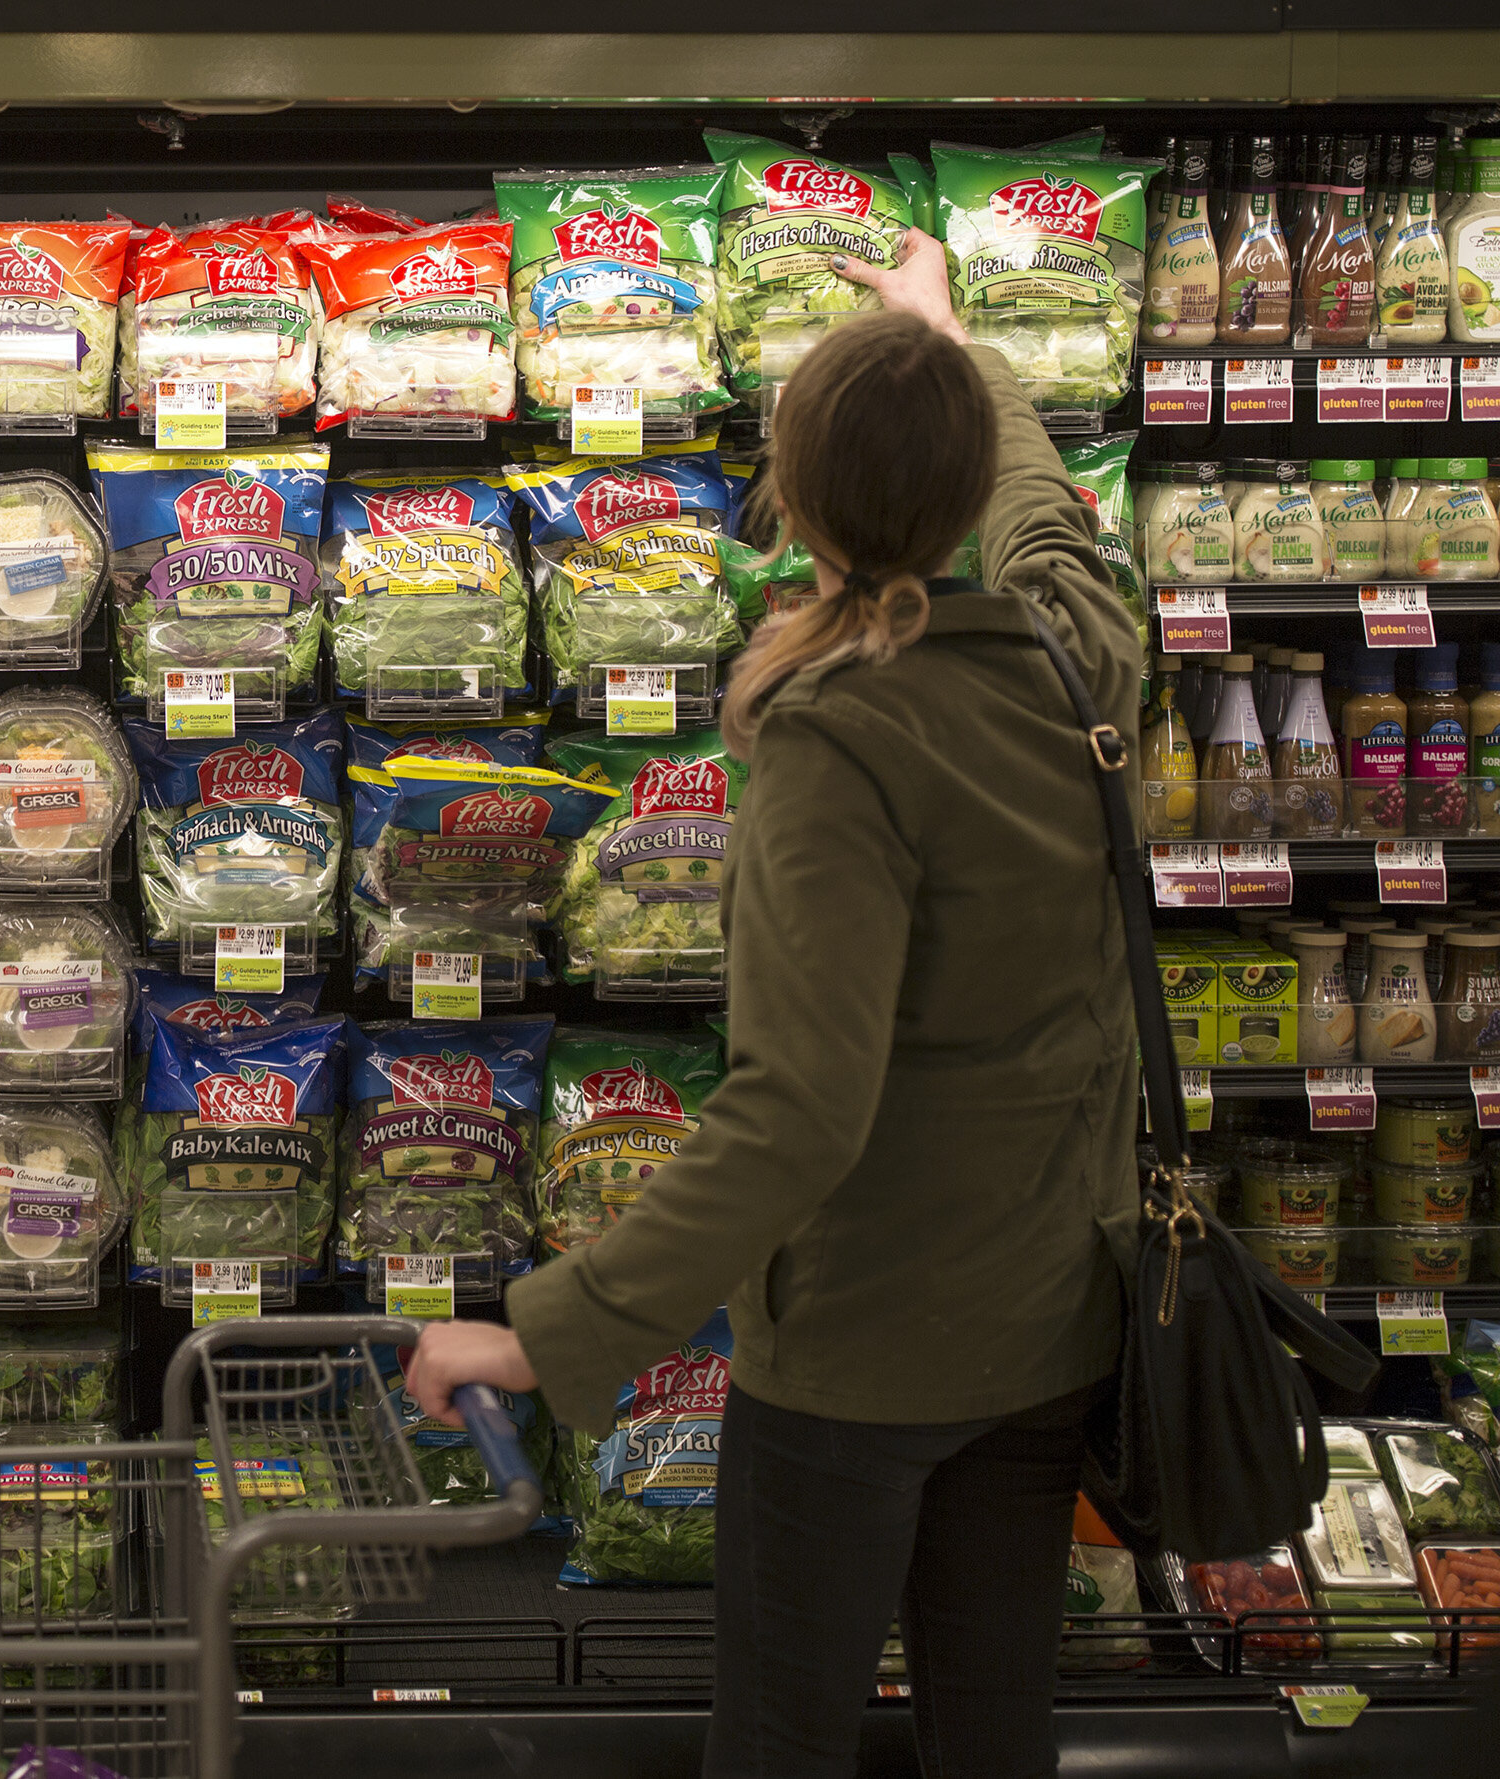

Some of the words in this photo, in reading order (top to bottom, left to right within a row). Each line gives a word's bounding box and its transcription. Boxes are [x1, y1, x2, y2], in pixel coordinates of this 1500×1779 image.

[780, 160, 860, 194] Fresh
[570, 218, 646, 243] Fresh
[570, 242, 648, 261] EXPRESS
[741, 229, 799, 261] Hearts
[798, 225, 820, 246] of
[819, 227, 884, 262] Romaine
[967, 250, 1030, 287] Hearts
[1030, 248, 1047, 270] of
[1047, 248, 1109, 285] Romaine
[1150, 251, 1215, 276] Marie's
[553, 271, 675, 300] American
[1182, 284, 1208, 294] WHITE
[189, 303, 248, 328] Iceberg
[248, 302, 304, 323] Garden
[1180, 307, 1215, 317] SHALLOT
[1149, 399, 1184, 412] gluten
[1185, 398, 1206, 411] free
[1389, 397, 1424, 411] gluten
[1424, 397, 1445, 410] free
[181, 423, 204, 431] Guiding
[192, 487, 270, 517] Fresh
[192, 517, 270, 534] EXPRESS
[594, 502, 668, 532] EXPRESS
[1242, 507, 1314, 533] Marie's
[1272, 536, 1301, 544] CREAMY
[1441, 540, 1489, 554] COLESLAW
[572, 546, 623, 573] Baby
[623, 529, 715, 566] Spinach
[1272, 543, 1312, 558] RANCH
[168, 550, 244, 586] 50/50
[248, 550, 299, 583] Mix
[1167, 627, 1203, 641] gluten
[1203, 627, 1225, 639] free
[1420, 734, 1467, 745] LITEHOUSE
[1422, 752, 1466, 762] BALSAMIC
[15, 763, 55, 776] Gourmet
[56, 763, 75, 775] Cafe
[213, 754, 290, 782] Fresh
[477, 770, 500, 780] EASY
[502, 772, 525, 781] OPEN
[527, 775, 550, 784] BAG
[458, 797, 536, 822] Fresh
[175, 812, 243, 850] Spinach
[244, 813, 260, 832] &
[260, 813, 325, 853] Arugula
[416, 844, 504, 862] Spring
[507, 845, 552, 865] Mix
[608, 827, 678, 863] Sweet
[1384, 878, 1421, 891] gluten
[1421, 878, 1441, 890] free
[22, 984, 89, 996] MEDITERRANEAN
[1233, 980, 1257, 996] CABO
[1258, 977, 1285, 996] FRESH
[1380, 977, 1418, 989] SIMPLY
[28, 993, 83, 1009] GREEK
[1380, 988, 1418, 999] DRESSED
[1223, 1002, 1293, 1015] guacamole
[170, 1138, 221, 1160] Baby
[226, 1134, 272, 1155] Kale
[272, 1138, 312, 1164] Mix
[362, 1119, 419, 1151] Sweet
[423, 1118, 439, 1136] &
[440, 1116, 517, 1164] Crunchy
[562, 1128, 627, 1162] Fancy
[647, 1359, 728, 1397] Fresh
